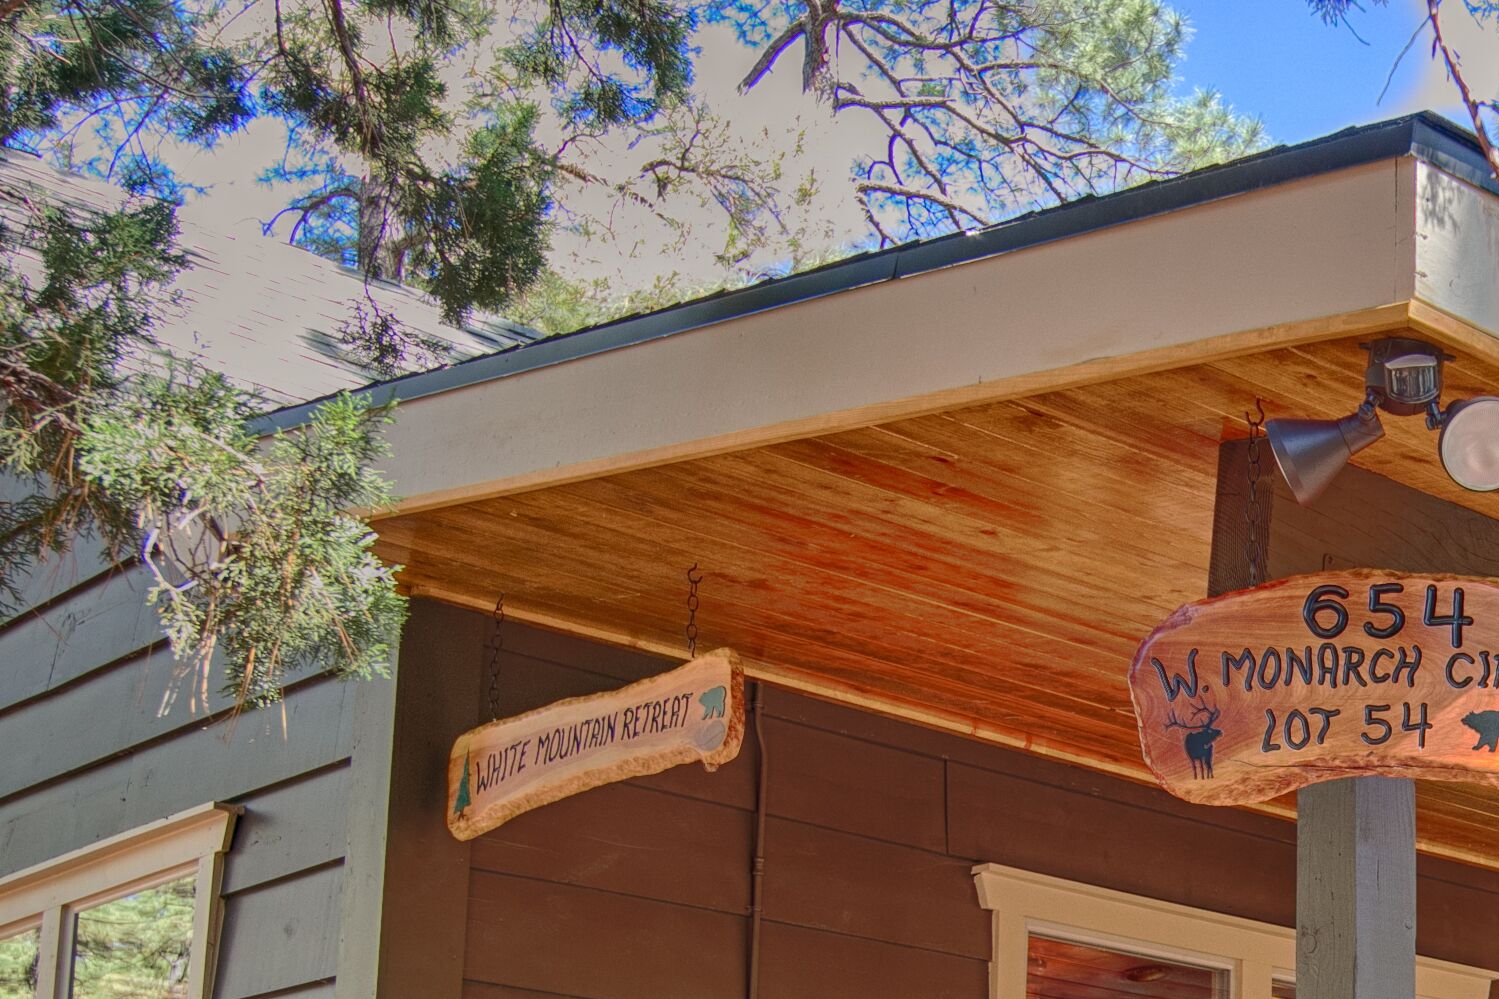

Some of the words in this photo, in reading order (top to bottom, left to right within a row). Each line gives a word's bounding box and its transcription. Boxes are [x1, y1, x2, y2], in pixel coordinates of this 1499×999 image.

[1302, 583, 1474, 648] 654
[1151, 648, 1210, 701] W.
[1221, 642, 1422, 692] MONARCH
[476, 739, 531, 796] WHITE
[535, 711, 618, 766] MOUNTAIN
[621, 692, 694, 740] RETREAT
[1260, 706, 1341, 753] LOT
[1360, 702, 1434, 750] 54
